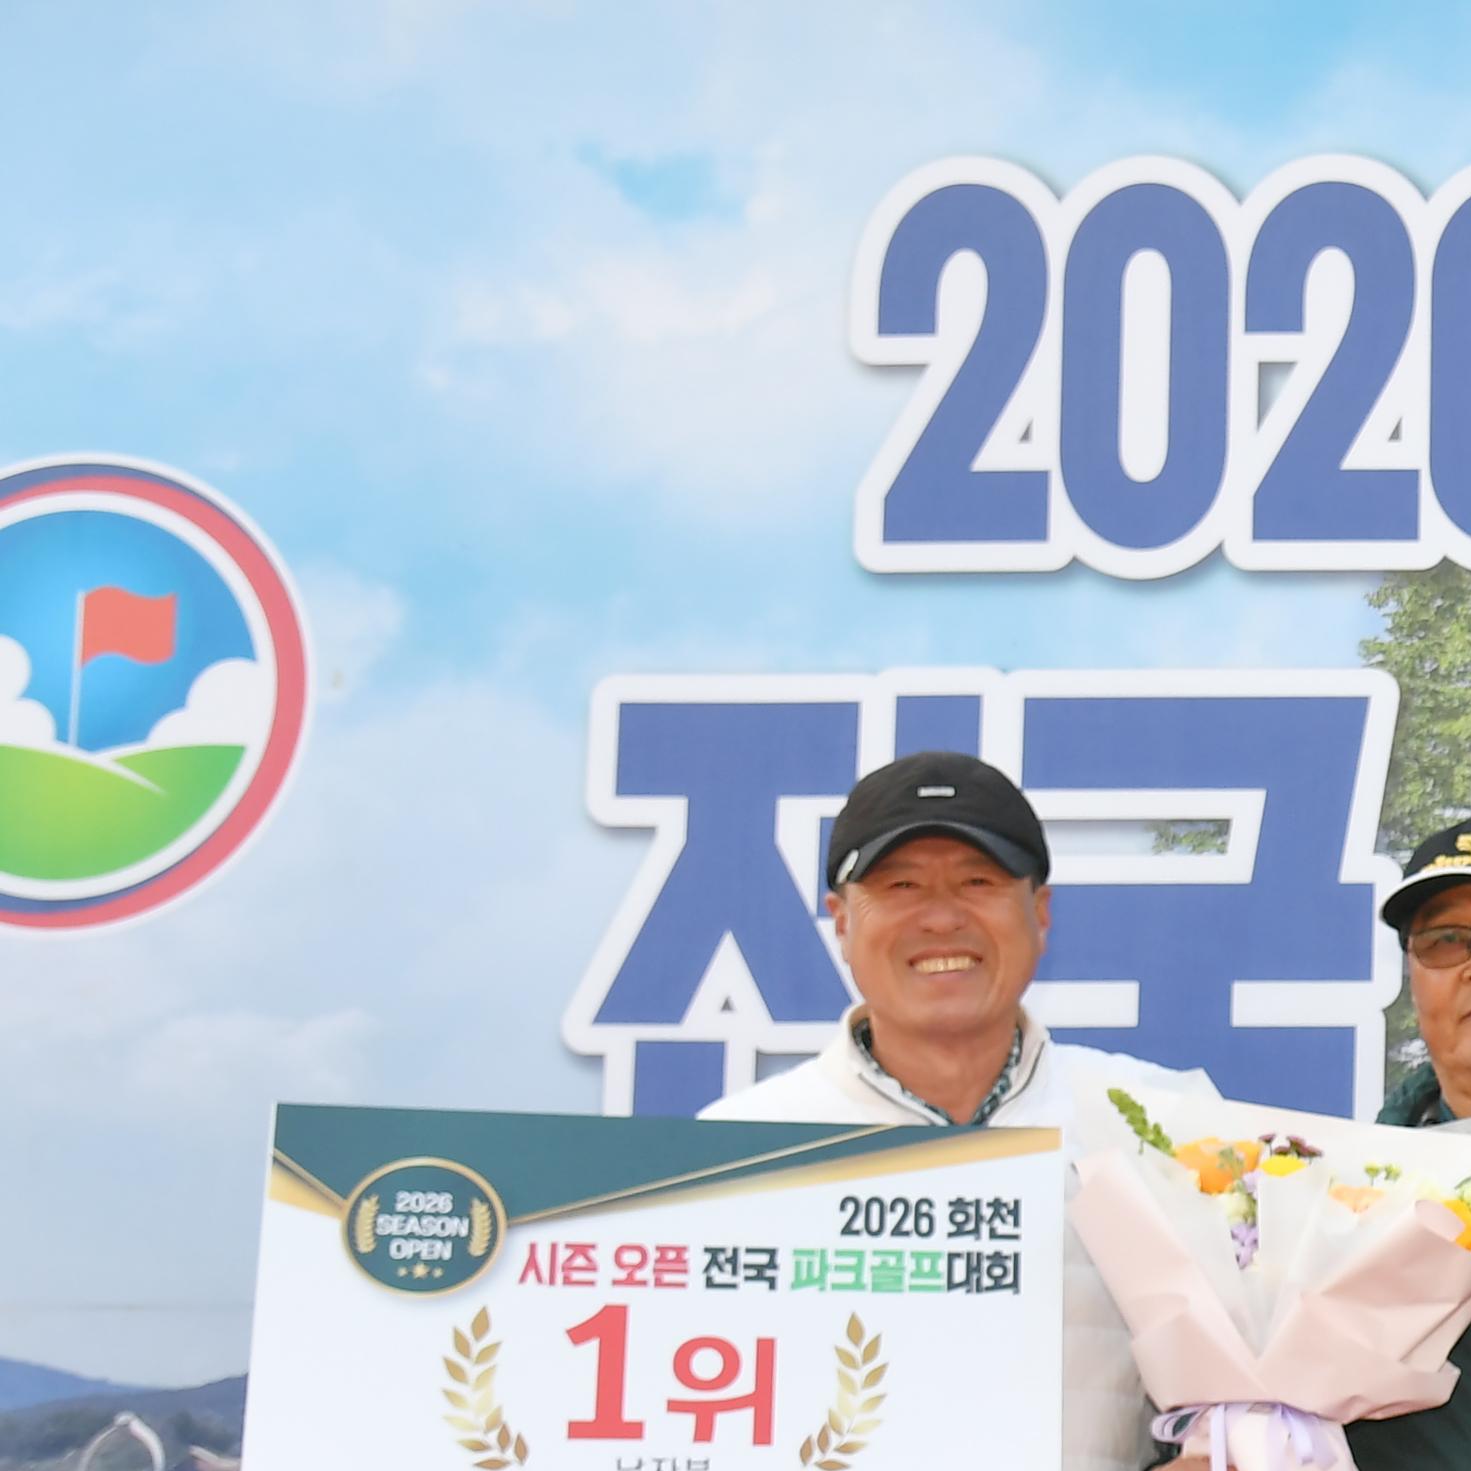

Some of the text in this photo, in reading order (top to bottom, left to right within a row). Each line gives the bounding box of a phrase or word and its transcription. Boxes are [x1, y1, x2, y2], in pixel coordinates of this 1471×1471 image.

[394, 1190, 454, 1214] 2026
[838, 1197, 1022, 1241] 2026 화천
[375, 1213, 470, 1238] SEASON
[388, 1237, 453, 1261] OPEN
[518, 1242, 1022, 1296] 시즌 오픈 전국 파크골프대회
[564, 1303, 779, 1447] 1위
